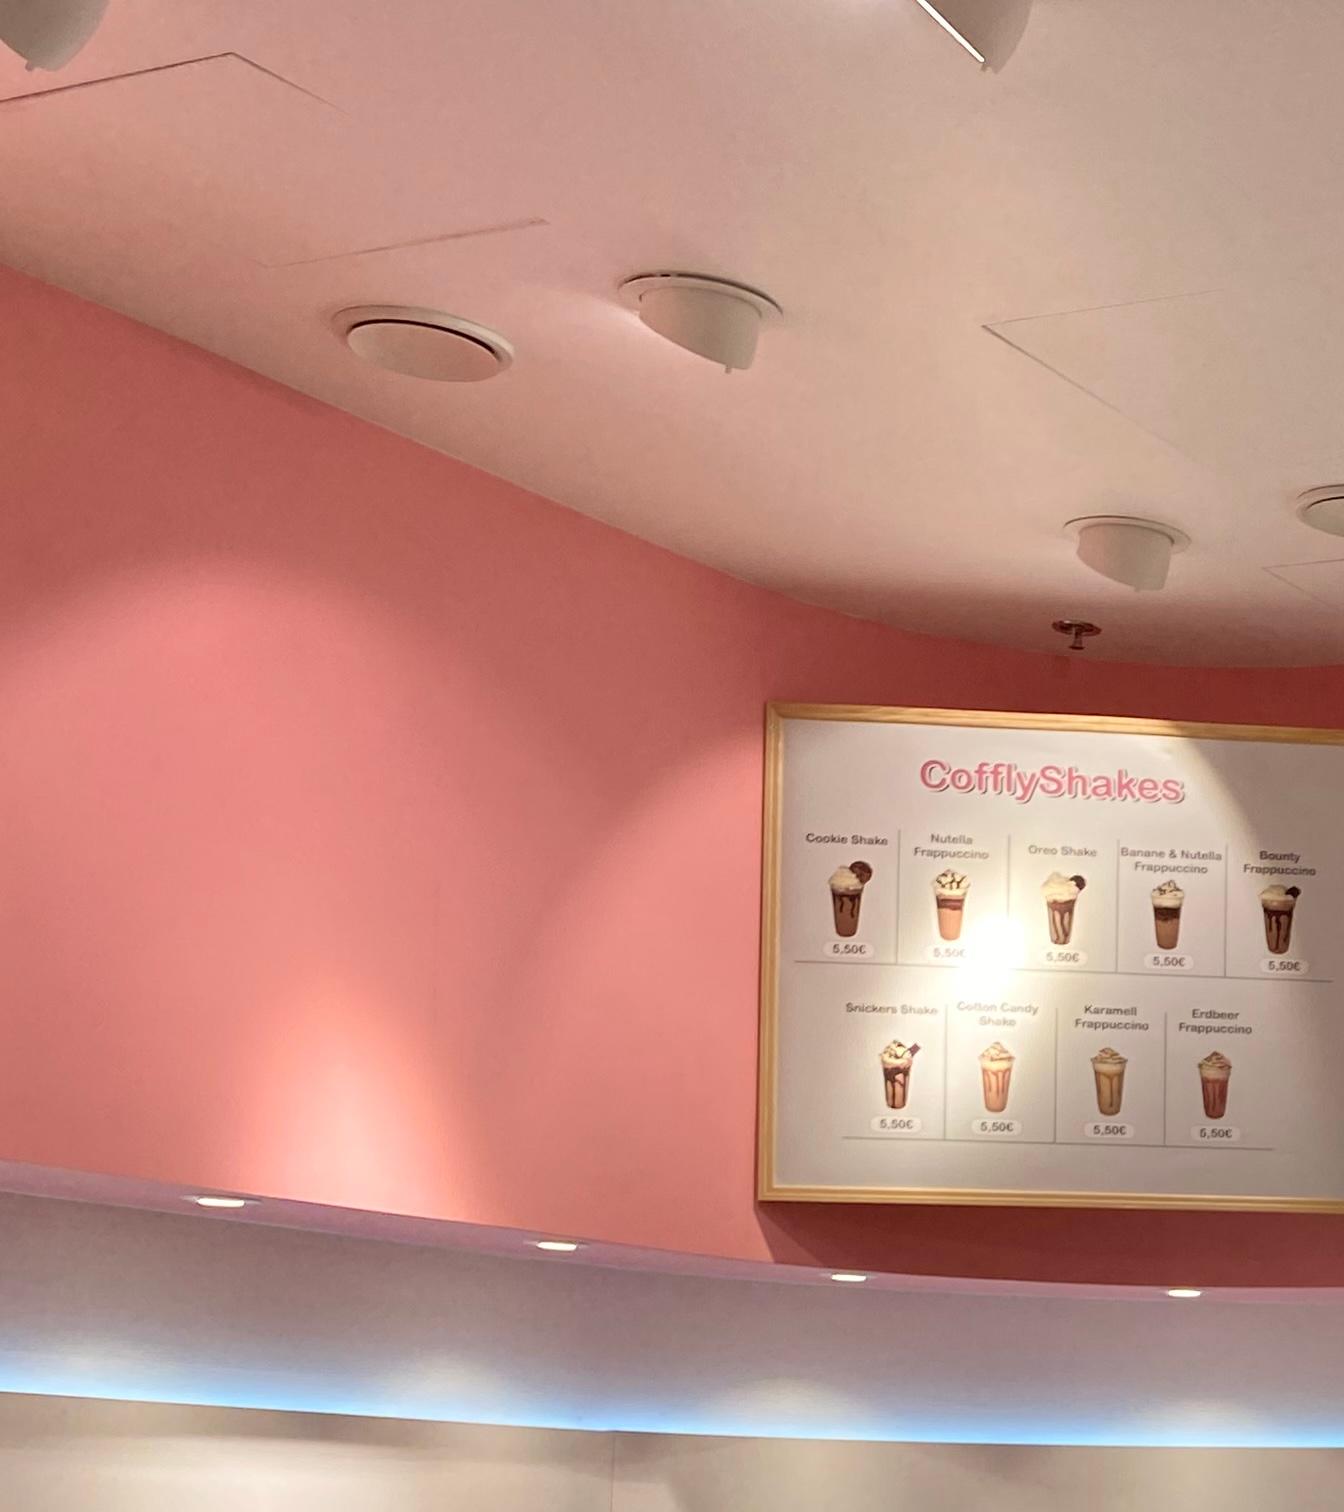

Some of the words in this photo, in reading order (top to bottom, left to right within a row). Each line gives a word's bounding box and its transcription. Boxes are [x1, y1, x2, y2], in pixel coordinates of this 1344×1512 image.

[920, 759, 1185, 805] CofflyShakes
[806, 832, 847, 845] Cookie
[852, 834, 888, 847] Shake
[930, 833, 973, 845] Nutella
[914, 847, 989, 861] Frappuccino
[1028, 845, 1057, 856] Oreo
[1061, 845, 1097, 858] Shake
[1121, 846, 1165, 859] Banane
[1180, 849, 1222, 861] Nutella
[1259, 851, 1300, 863] Bounty
[1134, 862, 1208, 875] Frappuccino
[1243, 864, 1316, 877] Frappuccino
[832, 944, 866, 955] 5,50€
[1084, 1005, 1137, 1016] Karamell
[1075, 1018, 1149, 1032] Frappuccino
